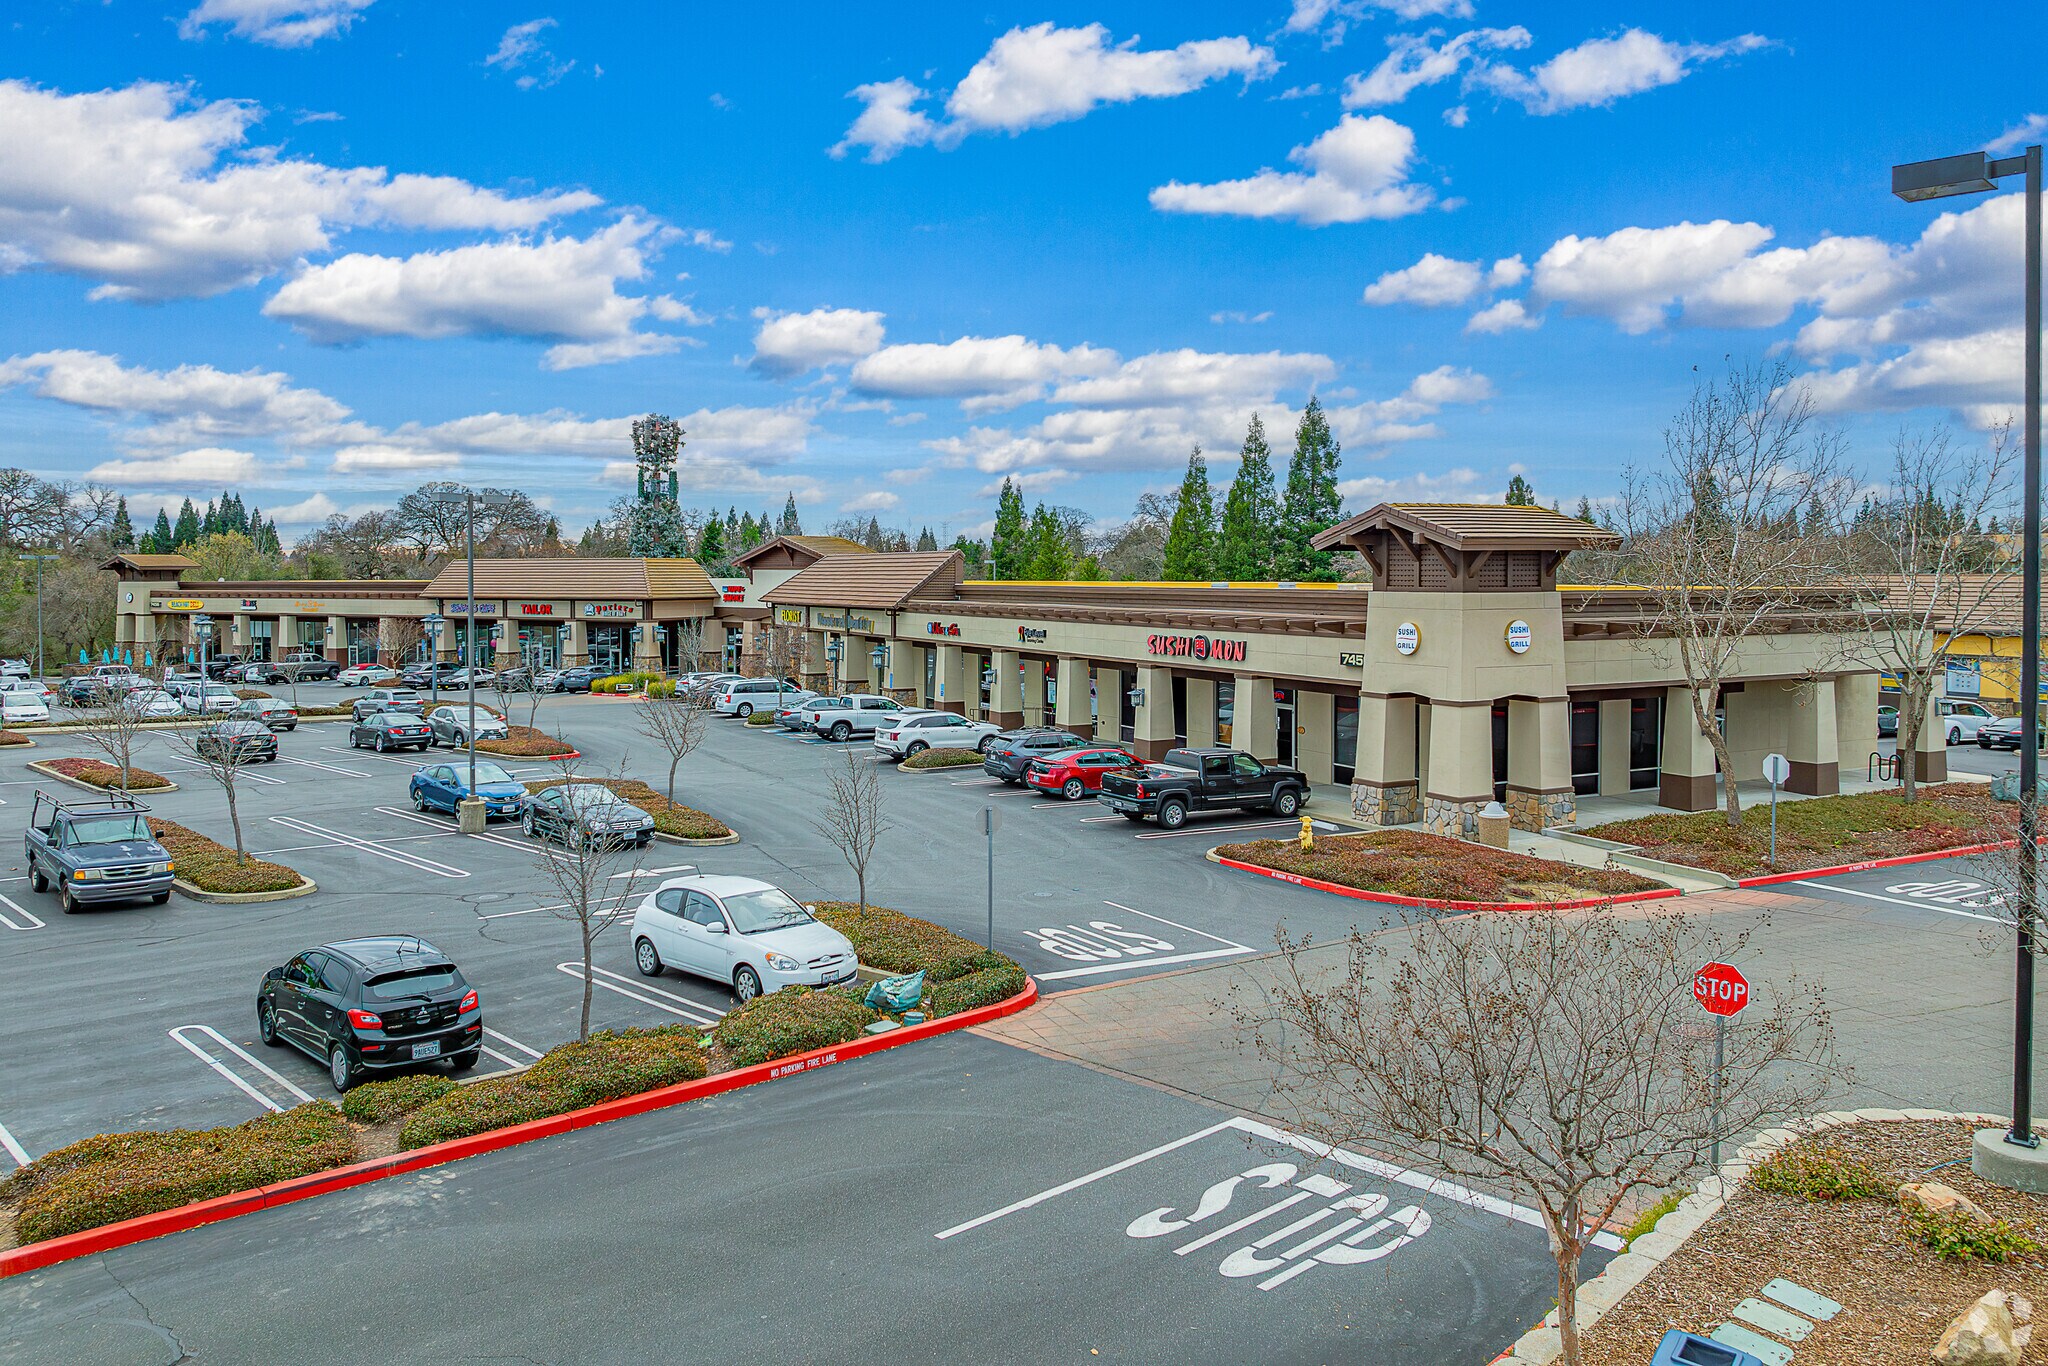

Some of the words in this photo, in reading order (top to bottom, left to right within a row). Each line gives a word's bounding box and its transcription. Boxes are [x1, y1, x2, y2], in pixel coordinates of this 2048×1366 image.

[520, 603, 553, 615] TAILOR
[781, 609, 802, 623] FLORIST
[1398, 628, 1416, 636] SUSHI
[1510, 626, 1529, 634] SUSHI
[1147, 634, 1192, 657] SUSHI
[1210, 639, 1247, 661] MON
[1022, 921, 1176, 962] STOP
[1695, 975, 1746, 1002] STOP
[770, 1068, 780, 1078] NO
[781, 1062, 804, 1075] PARKING
[807, 1057, 820, 1068] FIRE
[822, 1053, 836, 1064] LANE
[1126, 1163, 1432, 1292] STOP
